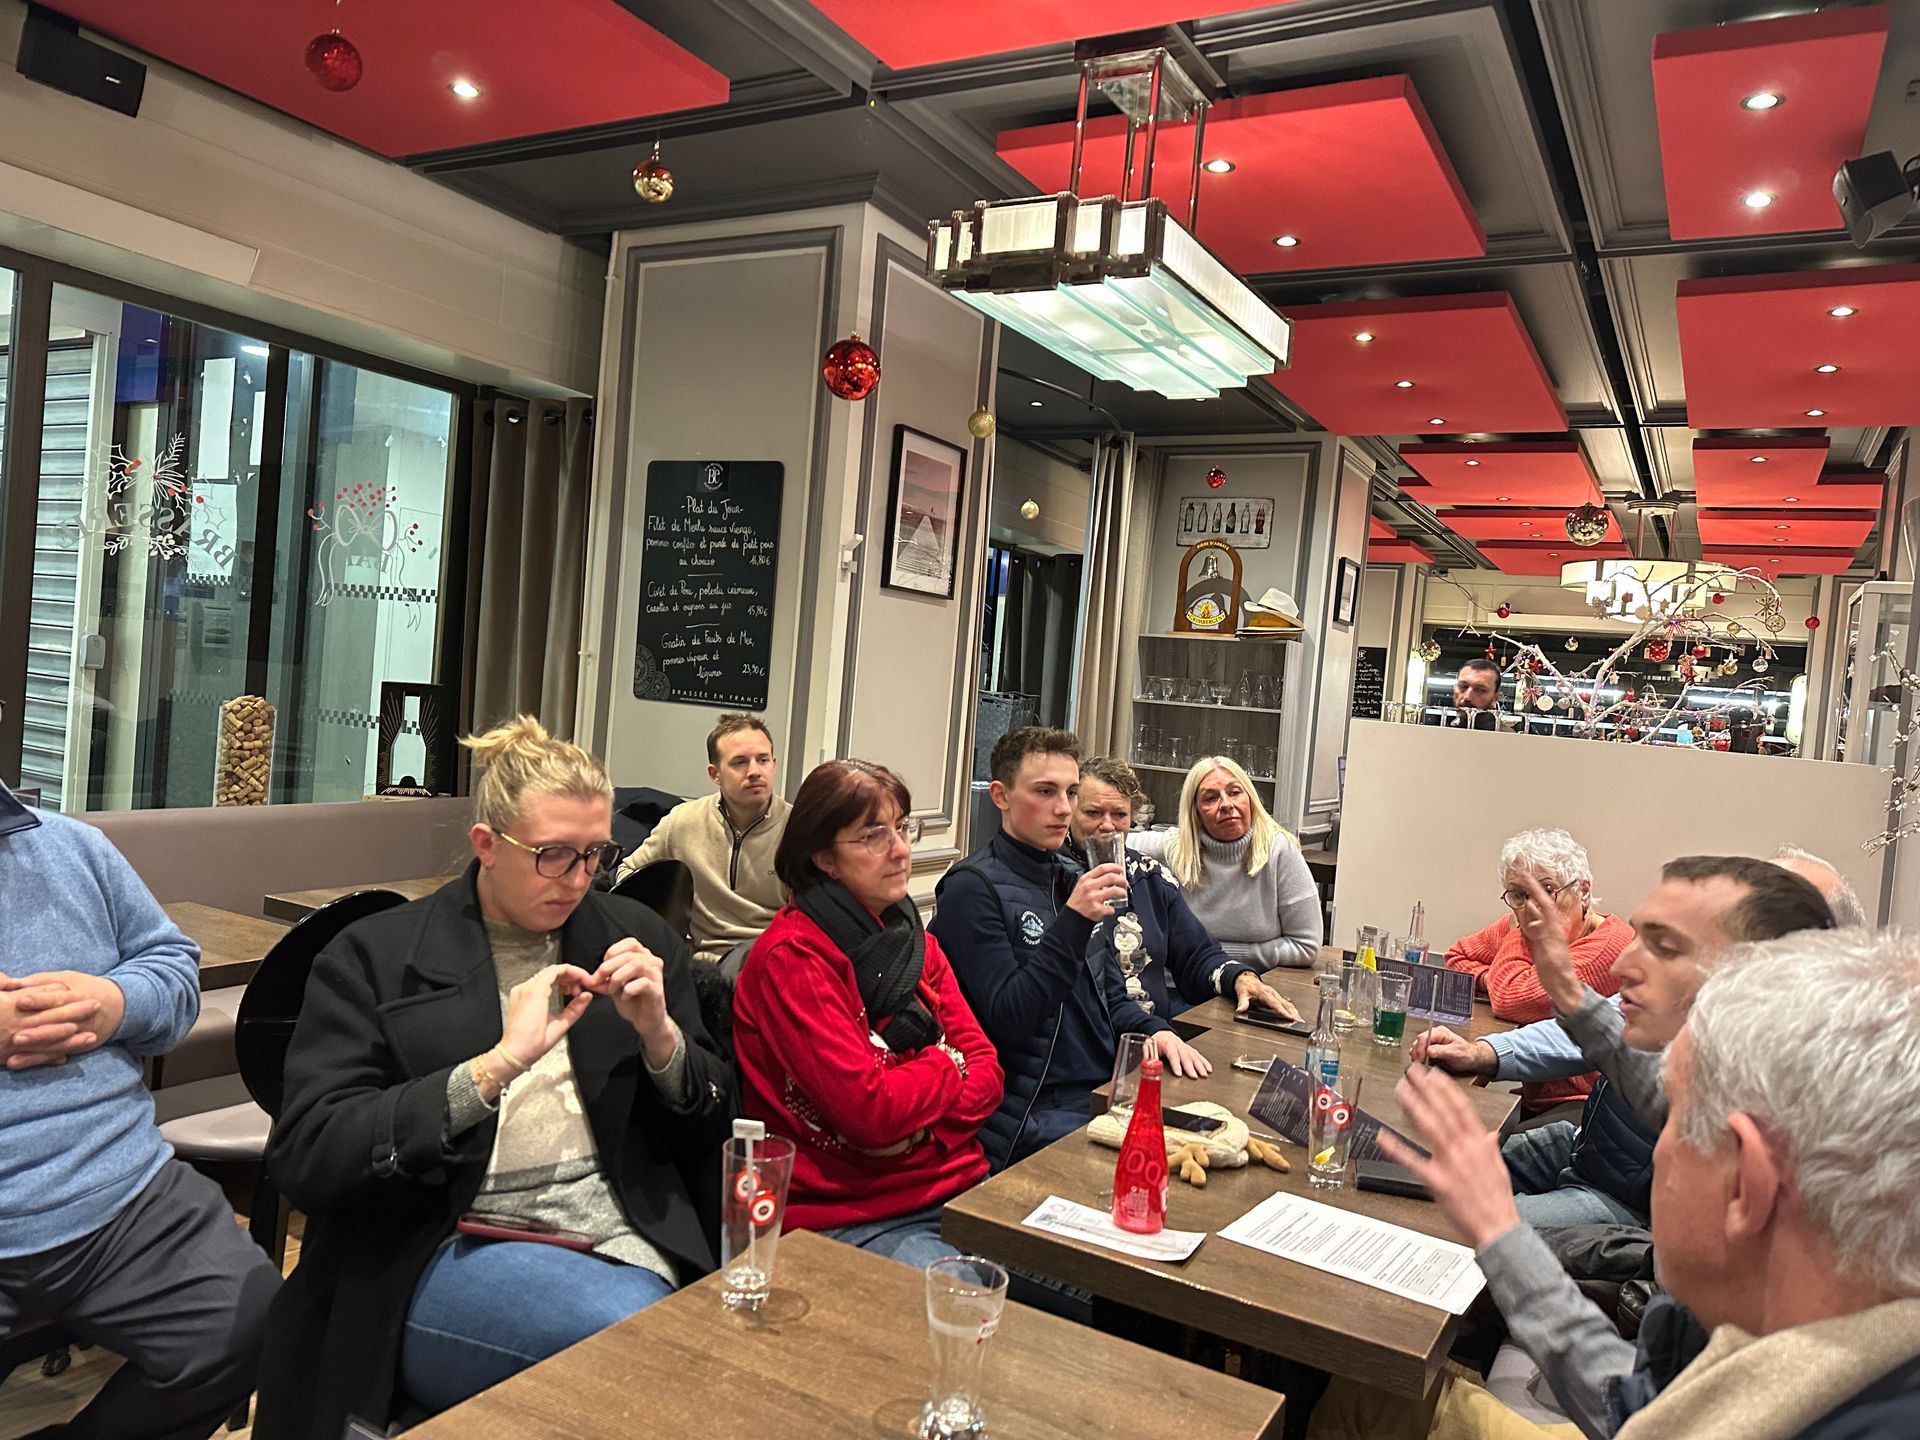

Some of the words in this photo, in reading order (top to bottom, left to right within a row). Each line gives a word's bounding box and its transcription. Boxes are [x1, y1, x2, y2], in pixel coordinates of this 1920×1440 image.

[708, 499, 719, 514] du
[648, 515, 666, 531] Filet
[671, 518, 681, 532] de
[699, 536, 708, 549] et
[731, 538, 740, 549] de
[679, 558, 688, 566] au
[648, 581, 666, 598] Civet
[670, 584, 679, 596] de
[699, 581, 724, 601] polenta
[672, 602, 680, 612] et
[661, 632, 687, 649] Gratin
[691, 633, 702, 646] de
[726, 632, 736, 644] de
[712, 650, 720, 661] et
[671, 688, 708, 698] BRASSÉE
[729, 694, 764, 704] FRANCE
